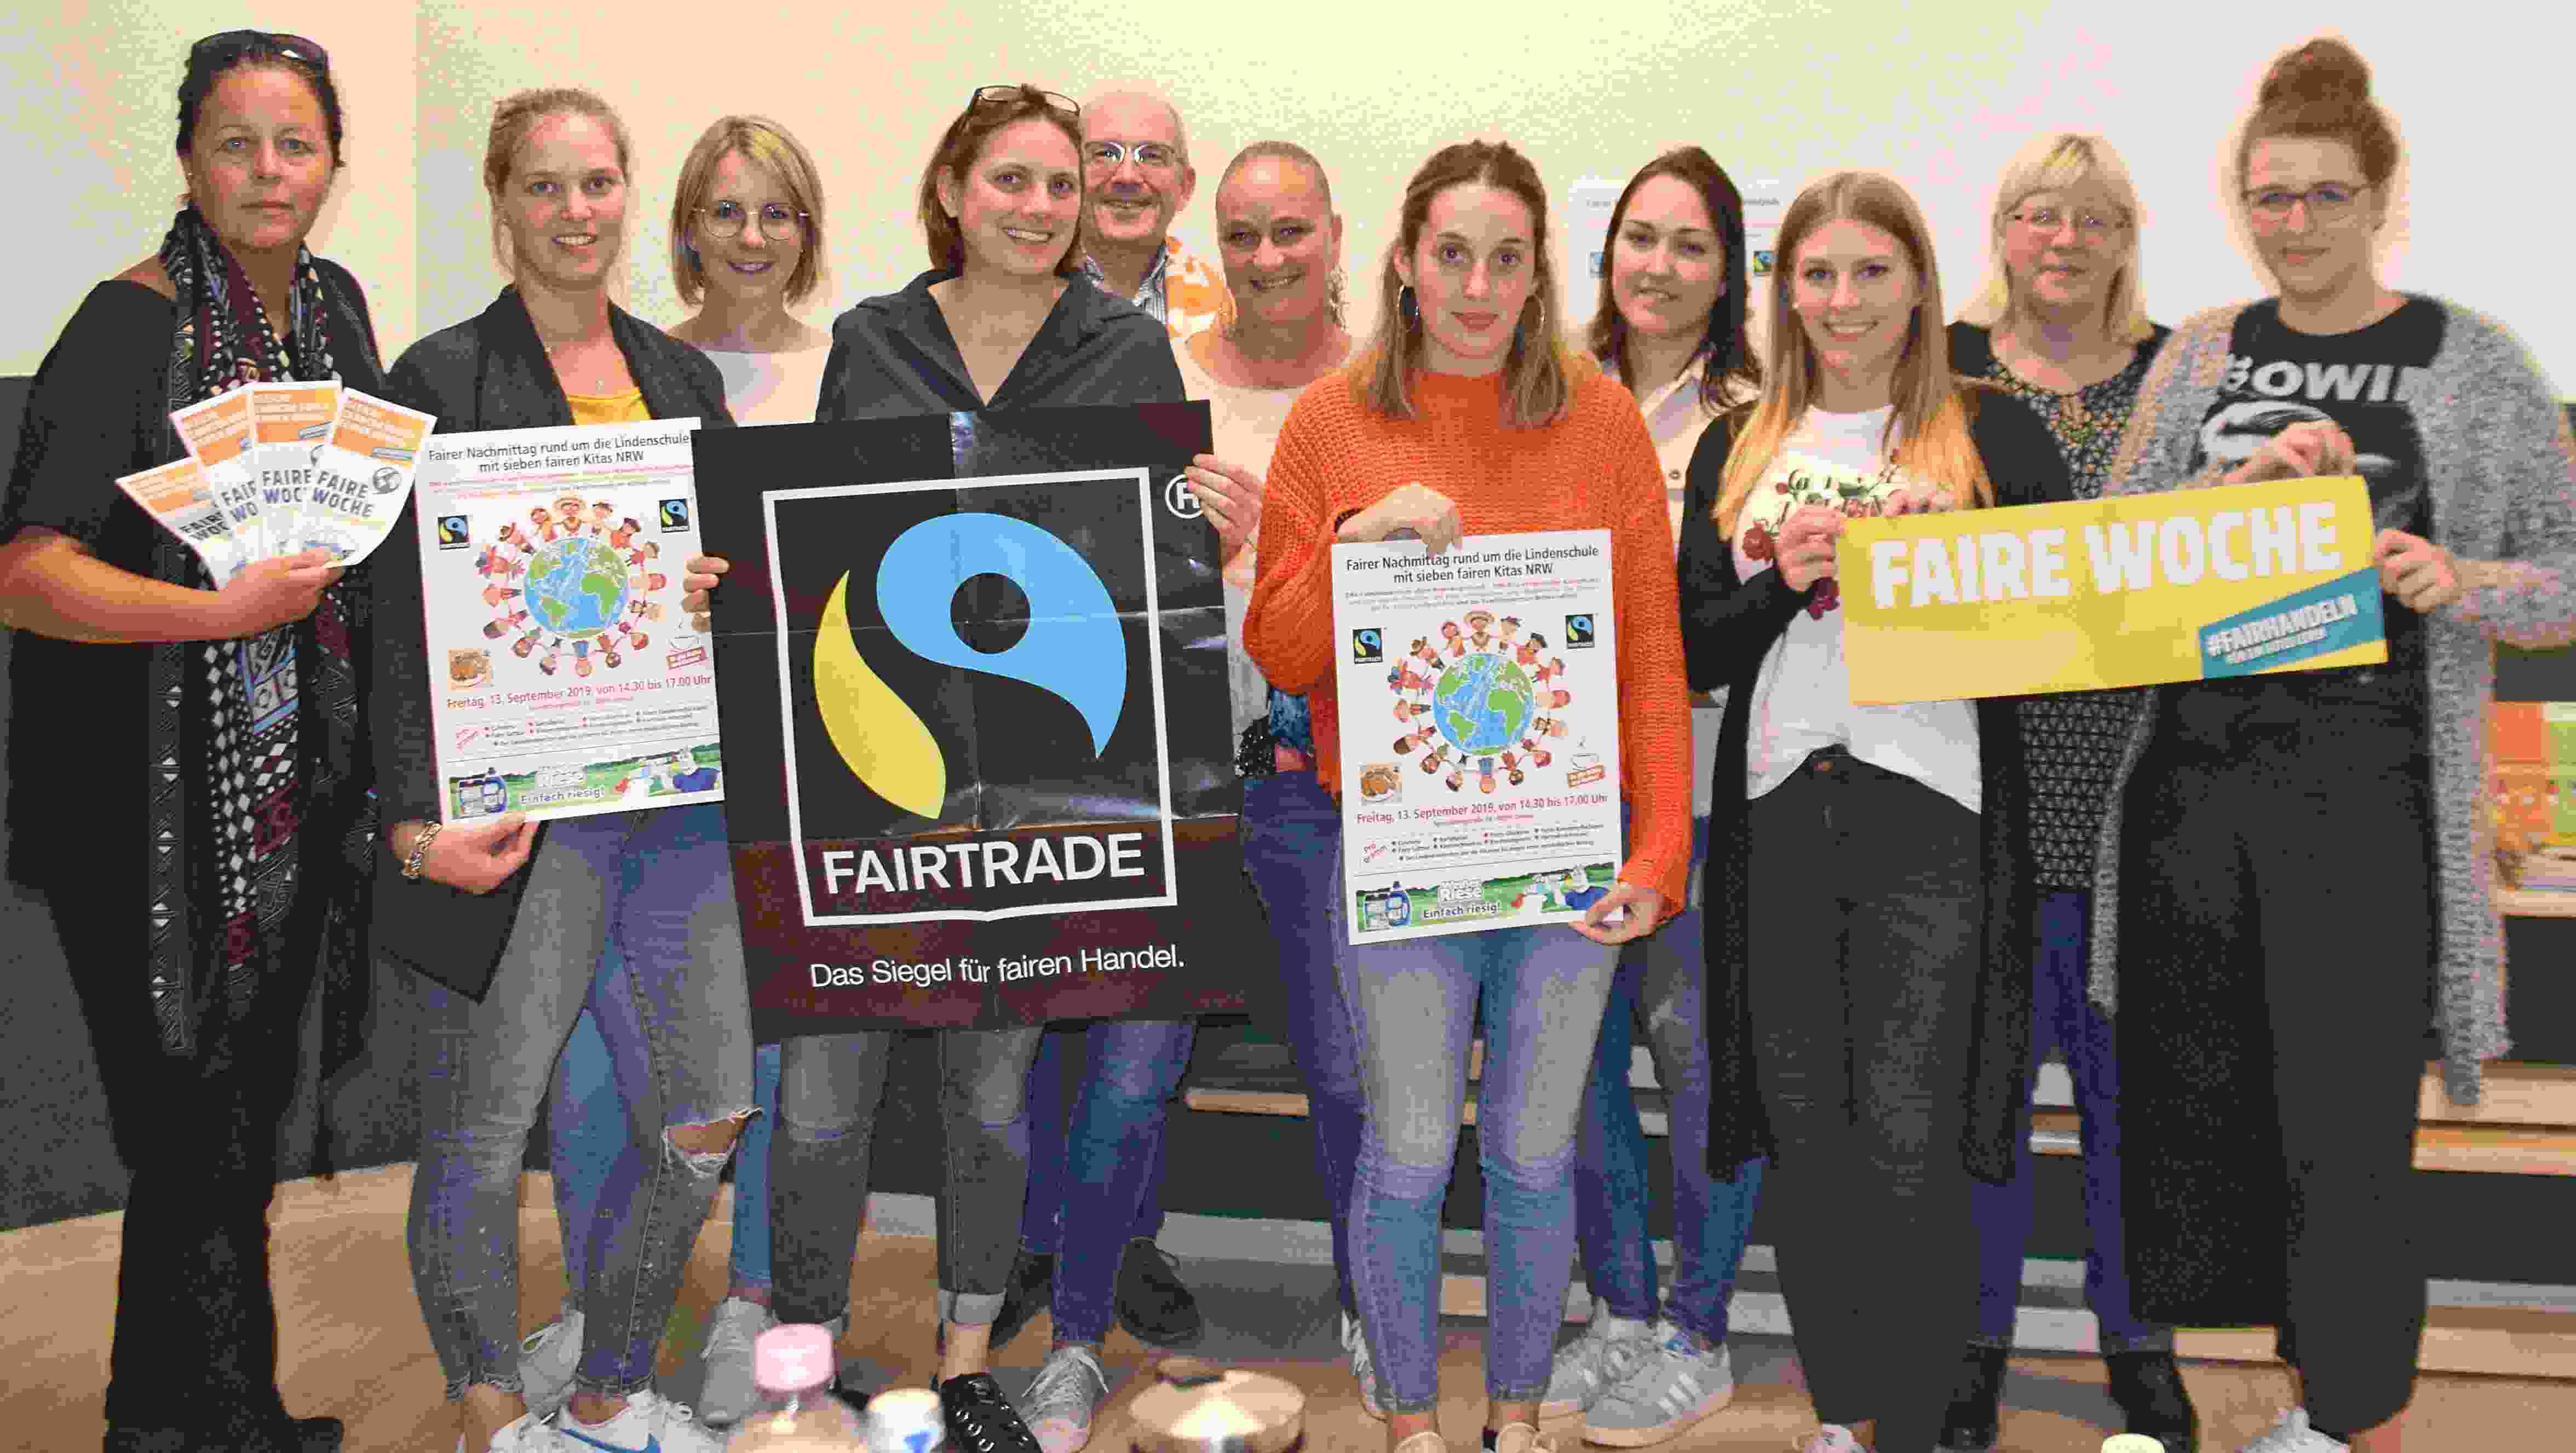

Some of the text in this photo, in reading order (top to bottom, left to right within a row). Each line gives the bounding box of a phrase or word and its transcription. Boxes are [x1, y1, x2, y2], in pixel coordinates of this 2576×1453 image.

[429, 447, 463, 460] Fairer
[467, 444, 537, 458] Nachmittag
[541, 439, 567, 452] rund
[572, 442, 590, 451] um
[594, 438, 611, 449] die
[614, 434, 690, 448] Lindenschule
[479, 451, 644, 473] mit sieben fairen Kitas NRW
[262, 469, 312, 487] FAIRE
[318, 470, 369, 498] FAIRE
[312, 487, 373, 518] WOCHE
[1346, 544, 1599, 570] Fairer Nachmittag rund um die Lindenschule
[1869, 500, 2343, 609] FAIRE WOCHE
[1394, 563, 1554, 583] mit sieben fairen Kitas NRW
[508, 690, 562, 704] September
[596, 685, 616, 694] von
[647, 679, 662, 690] bis
[1415, 805, 1468, 819] September
[1547, 797, 1561, 806] bis
[822, 832, 1146, 895] FAIRTRADE
[1424, 902, 1500, 919] Einfach riesig!
[809, 944, 1186, 988] Das Siegel für fairen Handel.
